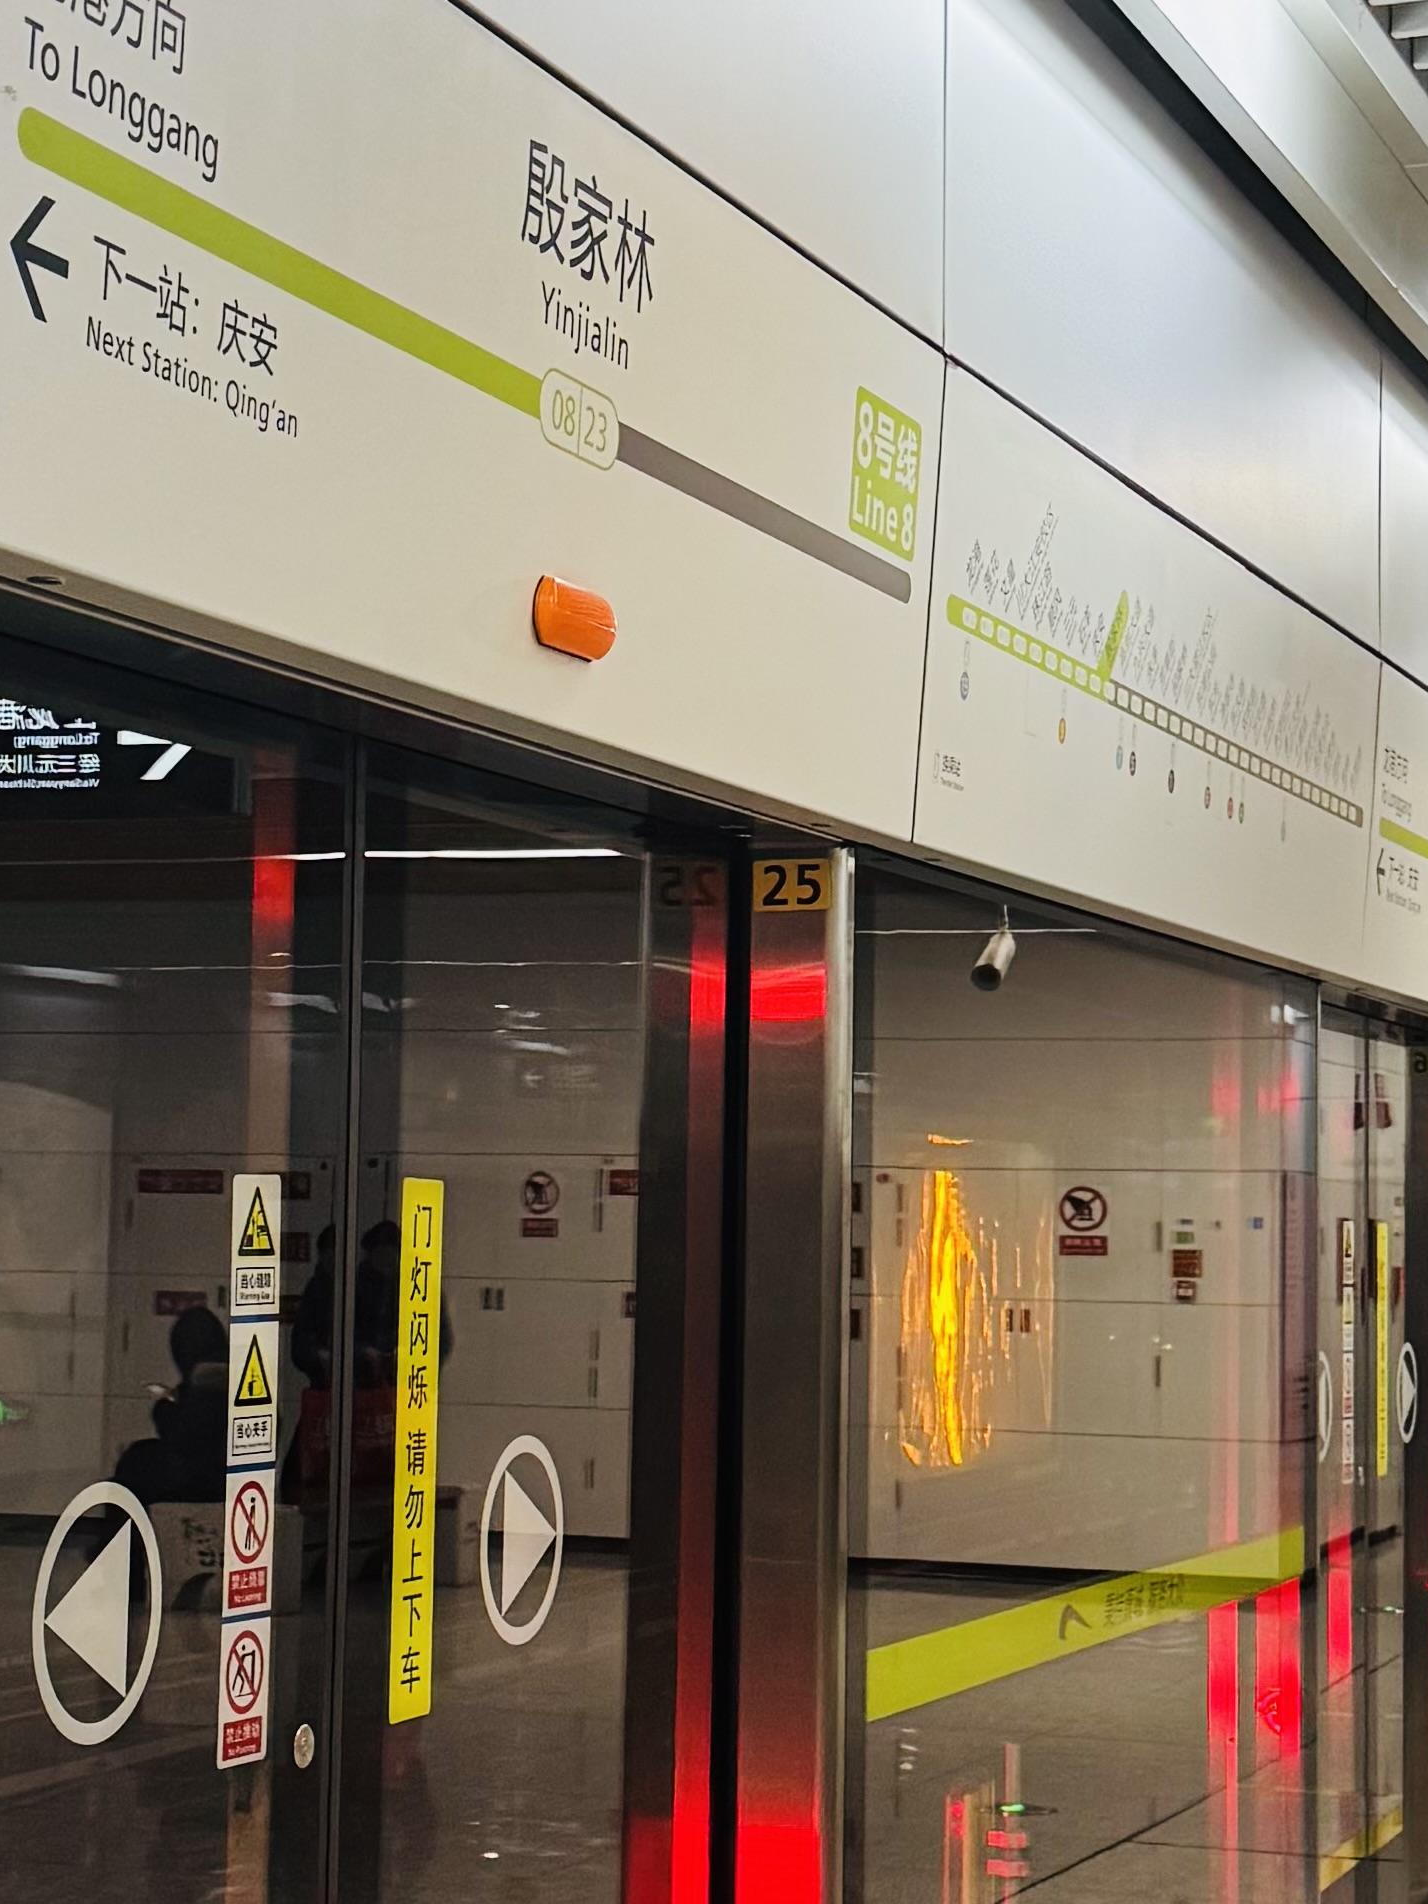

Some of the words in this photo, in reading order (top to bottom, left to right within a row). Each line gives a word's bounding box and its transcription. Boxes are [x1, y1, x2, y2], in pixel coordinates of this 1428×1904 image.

[24, 16, 60, 82] To
[71, 45, 220, 184] Longgang
[521, 139, 655, 313] 殷家林
[85, 315, 136, 367] Next
[141, 340, 219, 404] Station:
[541, 280, 630, 370] Yinjialin
[857, 401, 919, 495] 8号线
[852, 473, 898, 544] Line
[900, 503, 915, 552] 8
[760, 863, 823, 908] 25
[407, 1203, 434, 1410] 门灯闪烁
[399, 1430, 428, 1693] 请勿上下车
